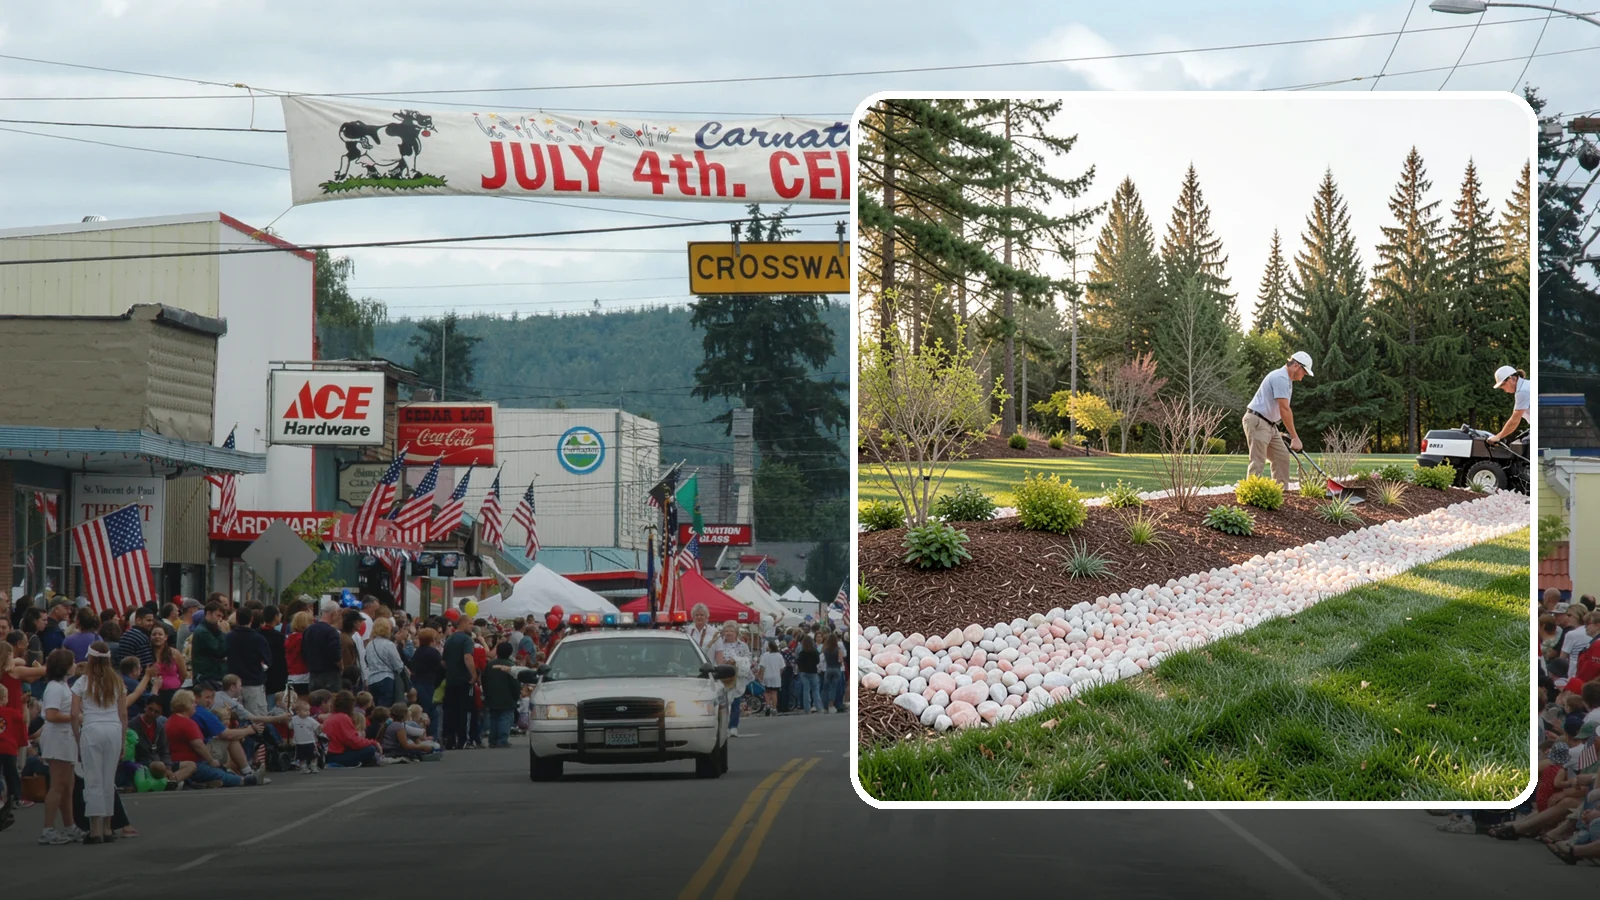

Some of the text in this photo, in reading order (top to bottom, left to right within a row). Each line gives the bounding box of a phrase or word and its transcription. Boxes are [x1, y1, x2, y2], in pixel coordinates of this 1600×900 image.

[481, 140, 604, 192] JULY
[632, 150, 746, 197] 4th.
[697, 254, 850, 279] CROSSWA
[283, 380, 373, 420] ACE
[405, 409, 452, 422] CEDAR
[283, 421, 370, 436] Hardware
[416, 428, 477, 447] Coca-Cola
[353, 467, 385, 480] Simpl
[95, 485, 124, 495] Vincent
[126, 486, 136, 495] de
[137, 486, 155, 495] Paul
[699, 535, 730, 543] GLASS
